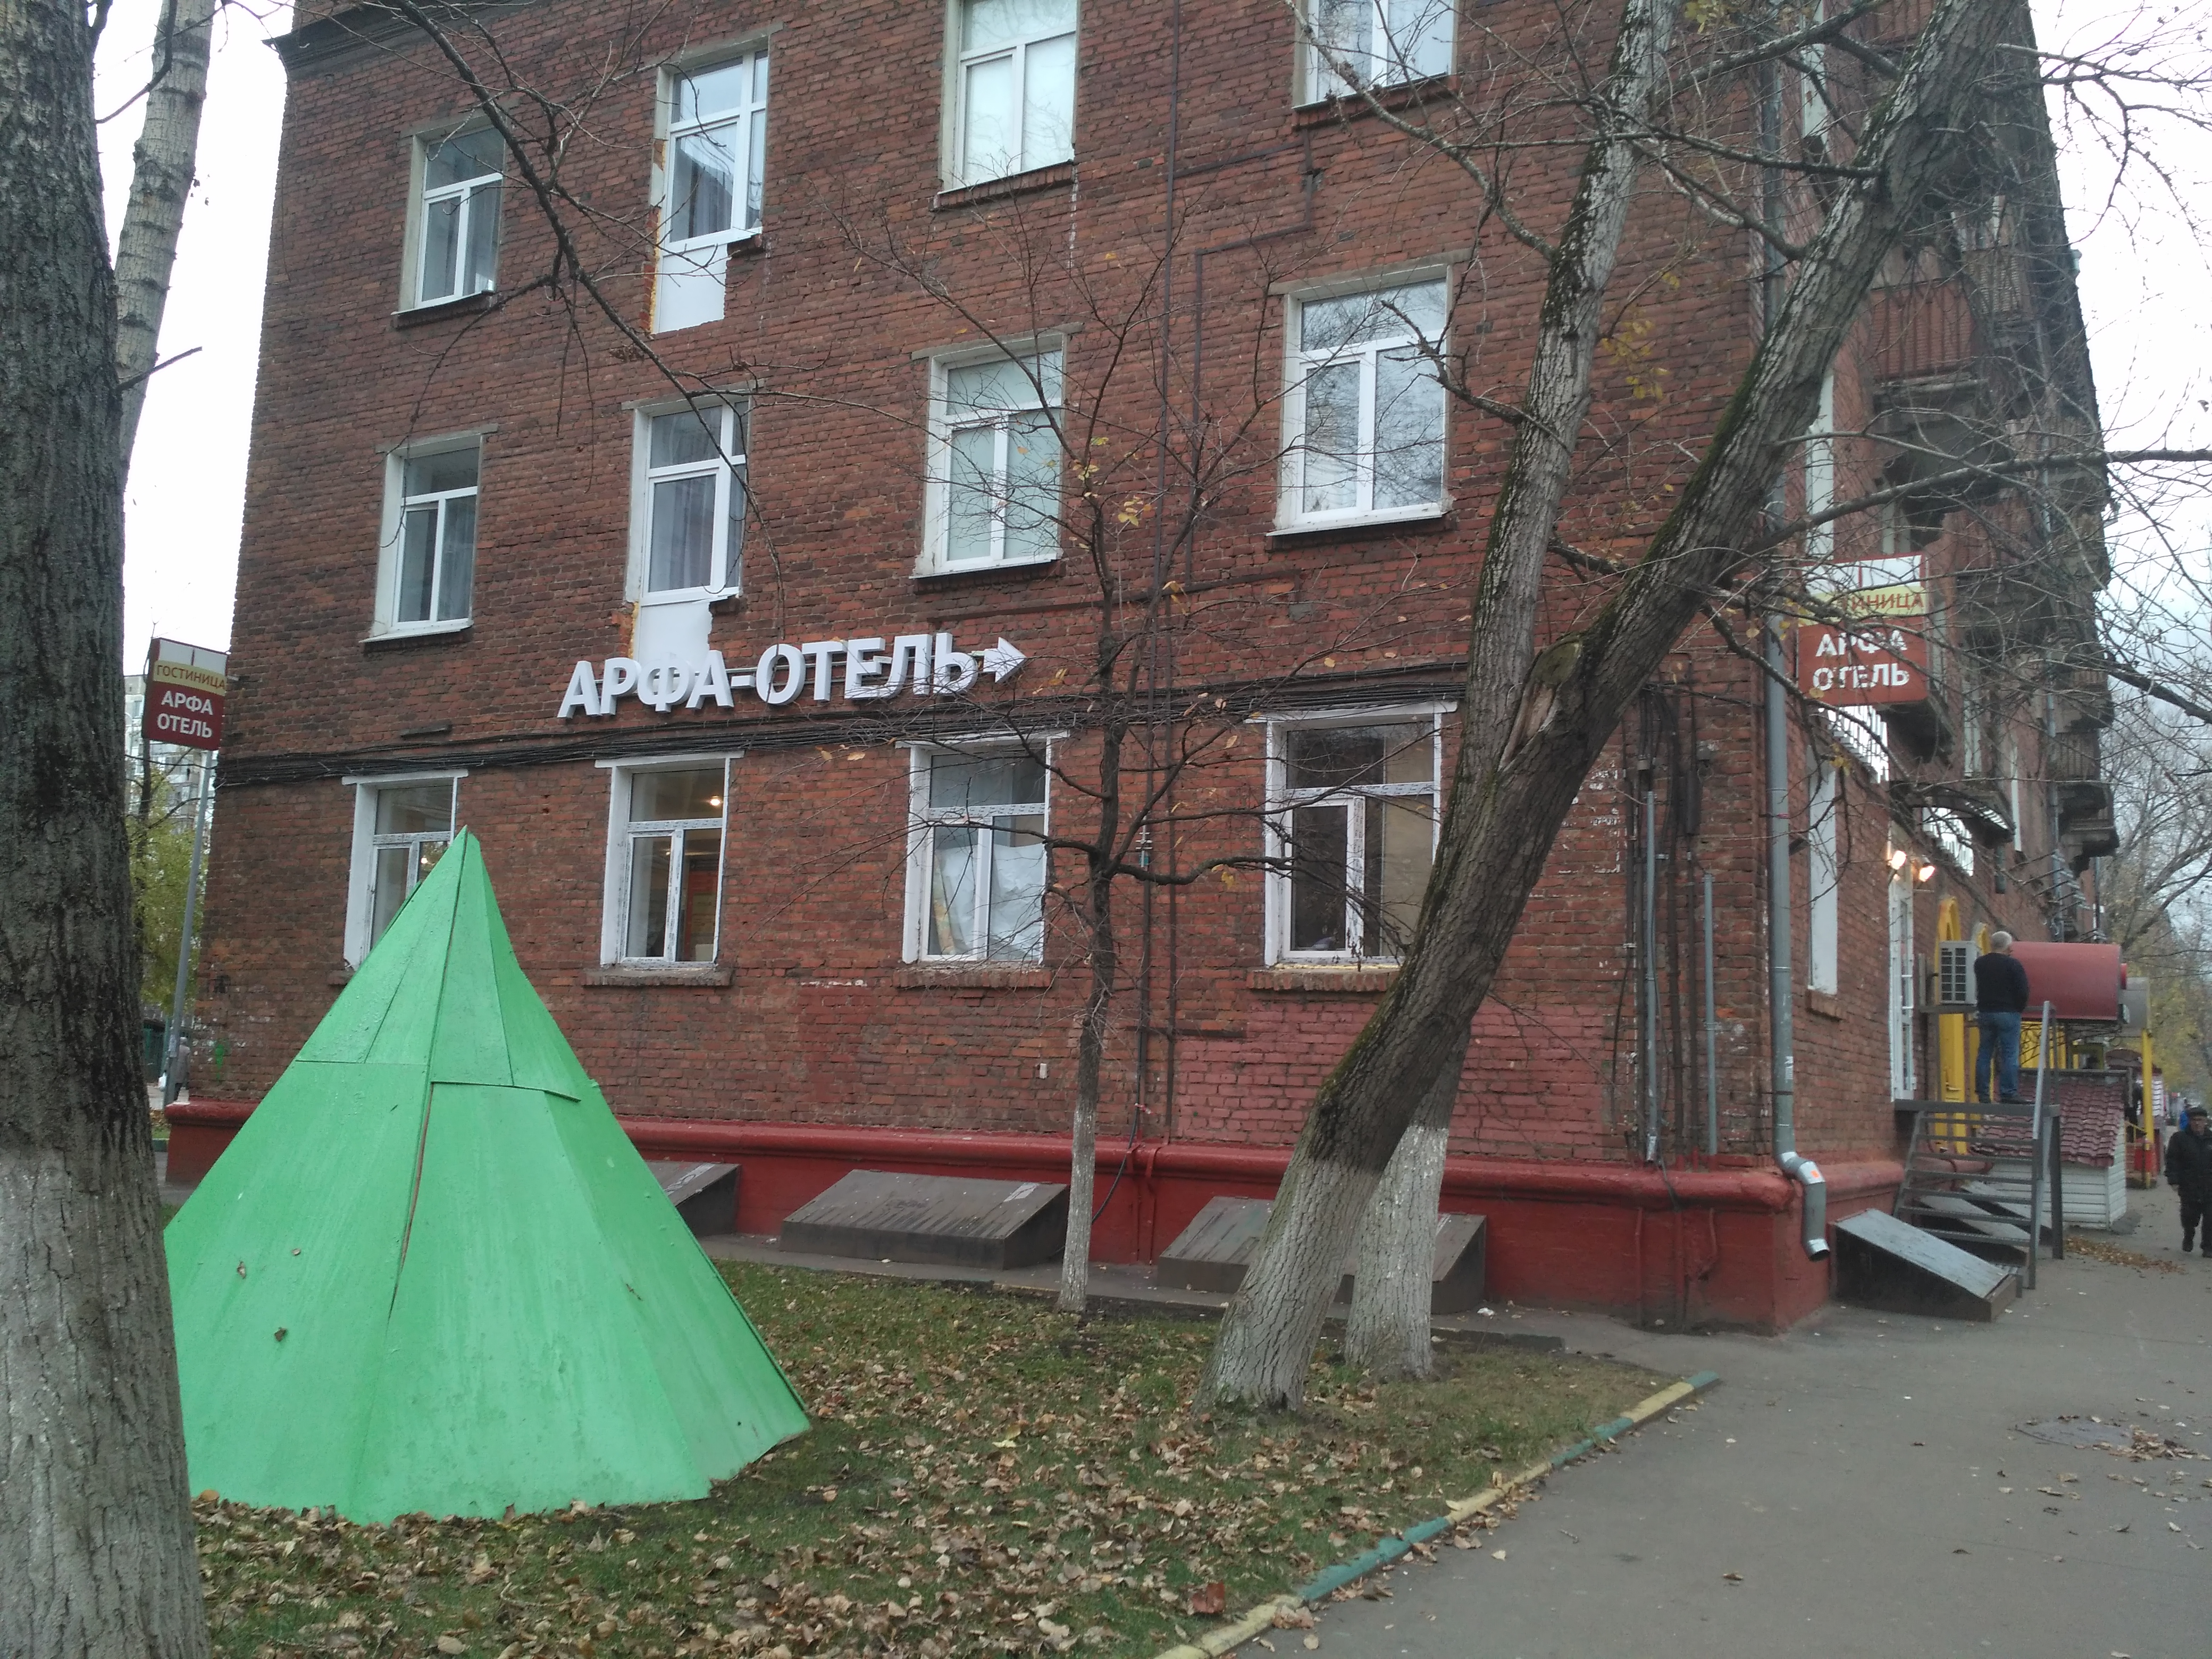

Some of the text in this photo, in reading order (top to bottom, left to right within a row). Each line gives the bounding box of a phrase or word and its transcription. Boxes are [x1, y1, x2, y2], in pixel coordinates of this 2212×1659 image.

[1805, 593, 1924, 614] ИНИЦА
[157, 665, 225, 689] ГОСТИНИЦА
[557, 632, 977, 719] АРФА-ОТЕЛЬ
[1813, 663, 1910, 691] ОТЕЛЬ
[161, 690, 213, 715] АРФА
[157, 713, 212, 738] ОТЕЛЬ
